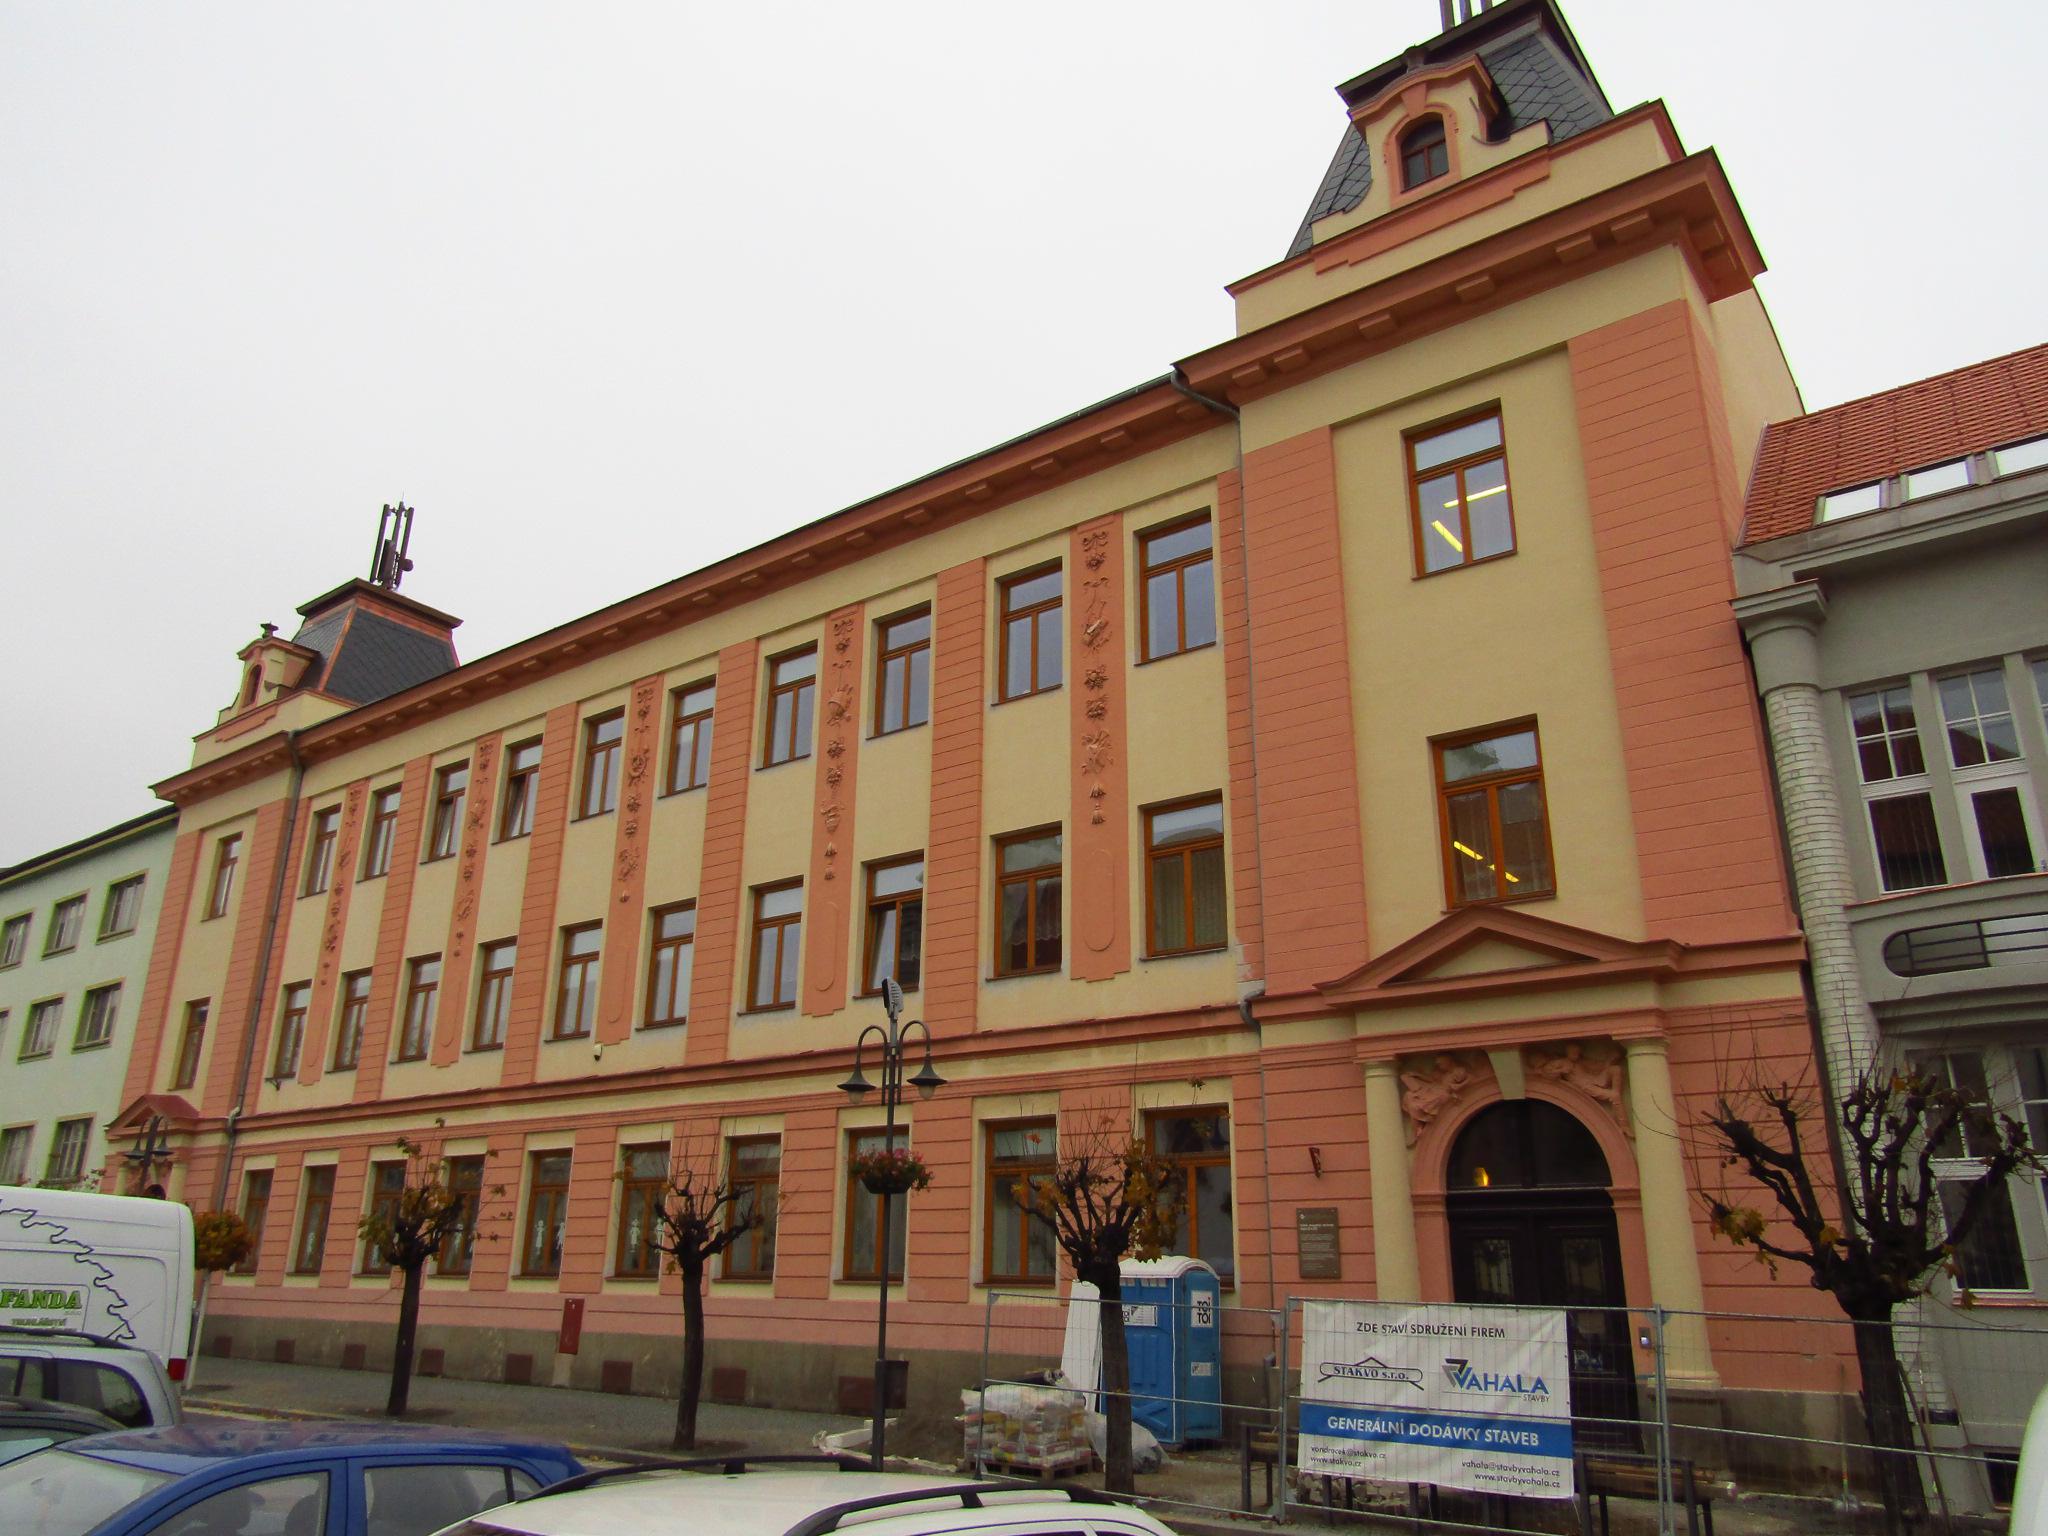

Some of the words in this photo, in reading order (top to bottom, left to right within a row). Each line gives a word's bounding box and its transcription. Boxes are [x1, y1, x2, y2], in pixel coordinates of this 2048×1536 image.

[0, 1289, 82, 1309] FANDA
[1356, 1322, 1378, 1333] ZDE
[1381, 1322, 1408, 1334] STAVÍ
[1410, 1323, 1467, 1336] SDRUŽENÍ
[1471, 1326, 1505, 1338] FIREM
[1333, 1366, 1379, 1378] STAKVO
[1382, 1372, 1409, 1380] s.r.o.
[1453, 1366, 1549, 1394] VAHALA
[1523, 1394, 1550, 1403] STAVBY
[1327, 1415, 1404, 1435] GENERÁLNÍ
[1409, 1422, 1480, 1441] DODÁVKY
[1485, 1429, 1539, 1446] STAVEB
[1461, 1459, 1560, 1476] vahala@stavbyvahala.cz
[1474, 1472, 1560, 1488] www.stavbyvahala.cz
